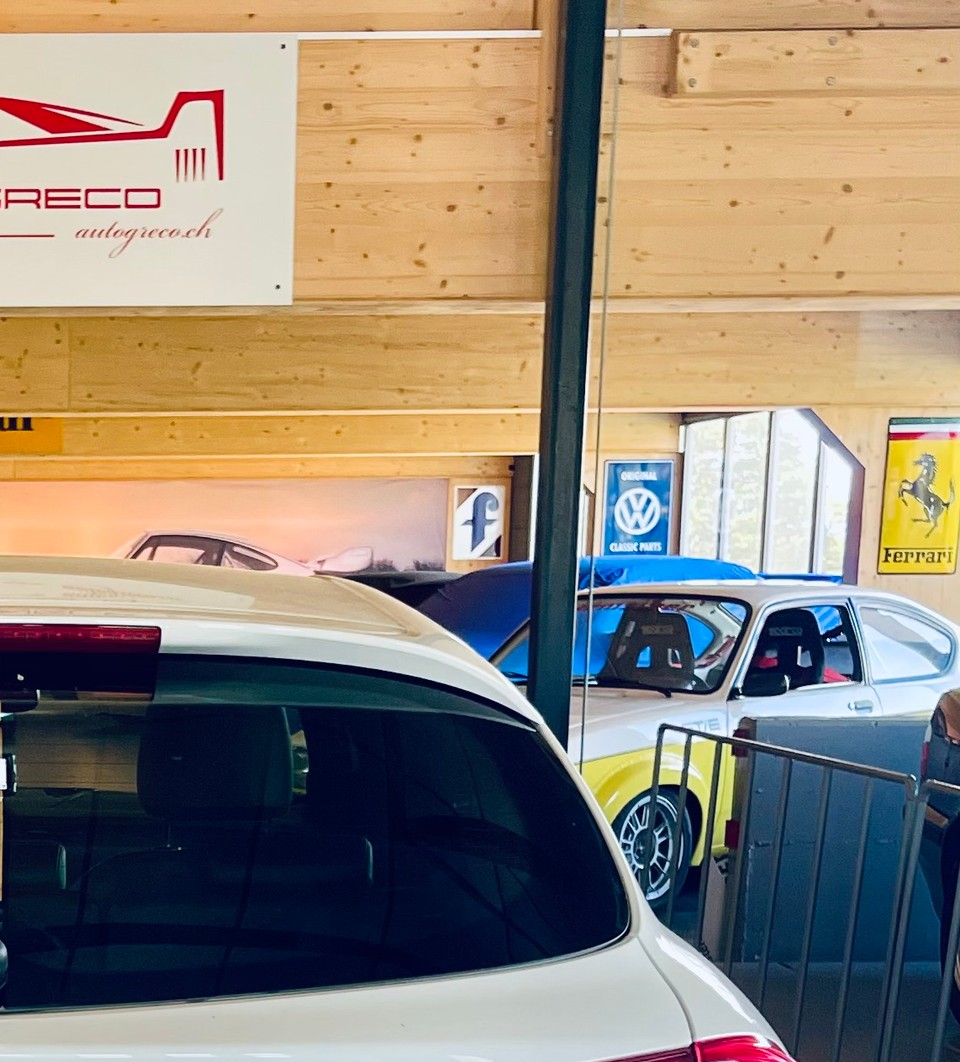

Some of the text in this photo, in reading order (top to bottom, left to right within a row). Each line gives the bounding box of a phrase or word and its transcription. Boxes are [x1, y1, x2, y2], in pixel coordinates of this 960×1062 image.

[75, 208, 224, 258] autogreco.ch
[609, 542, 662, 552] CLASSIC PARTS
[882, 547, 953, 564] Ferrari
